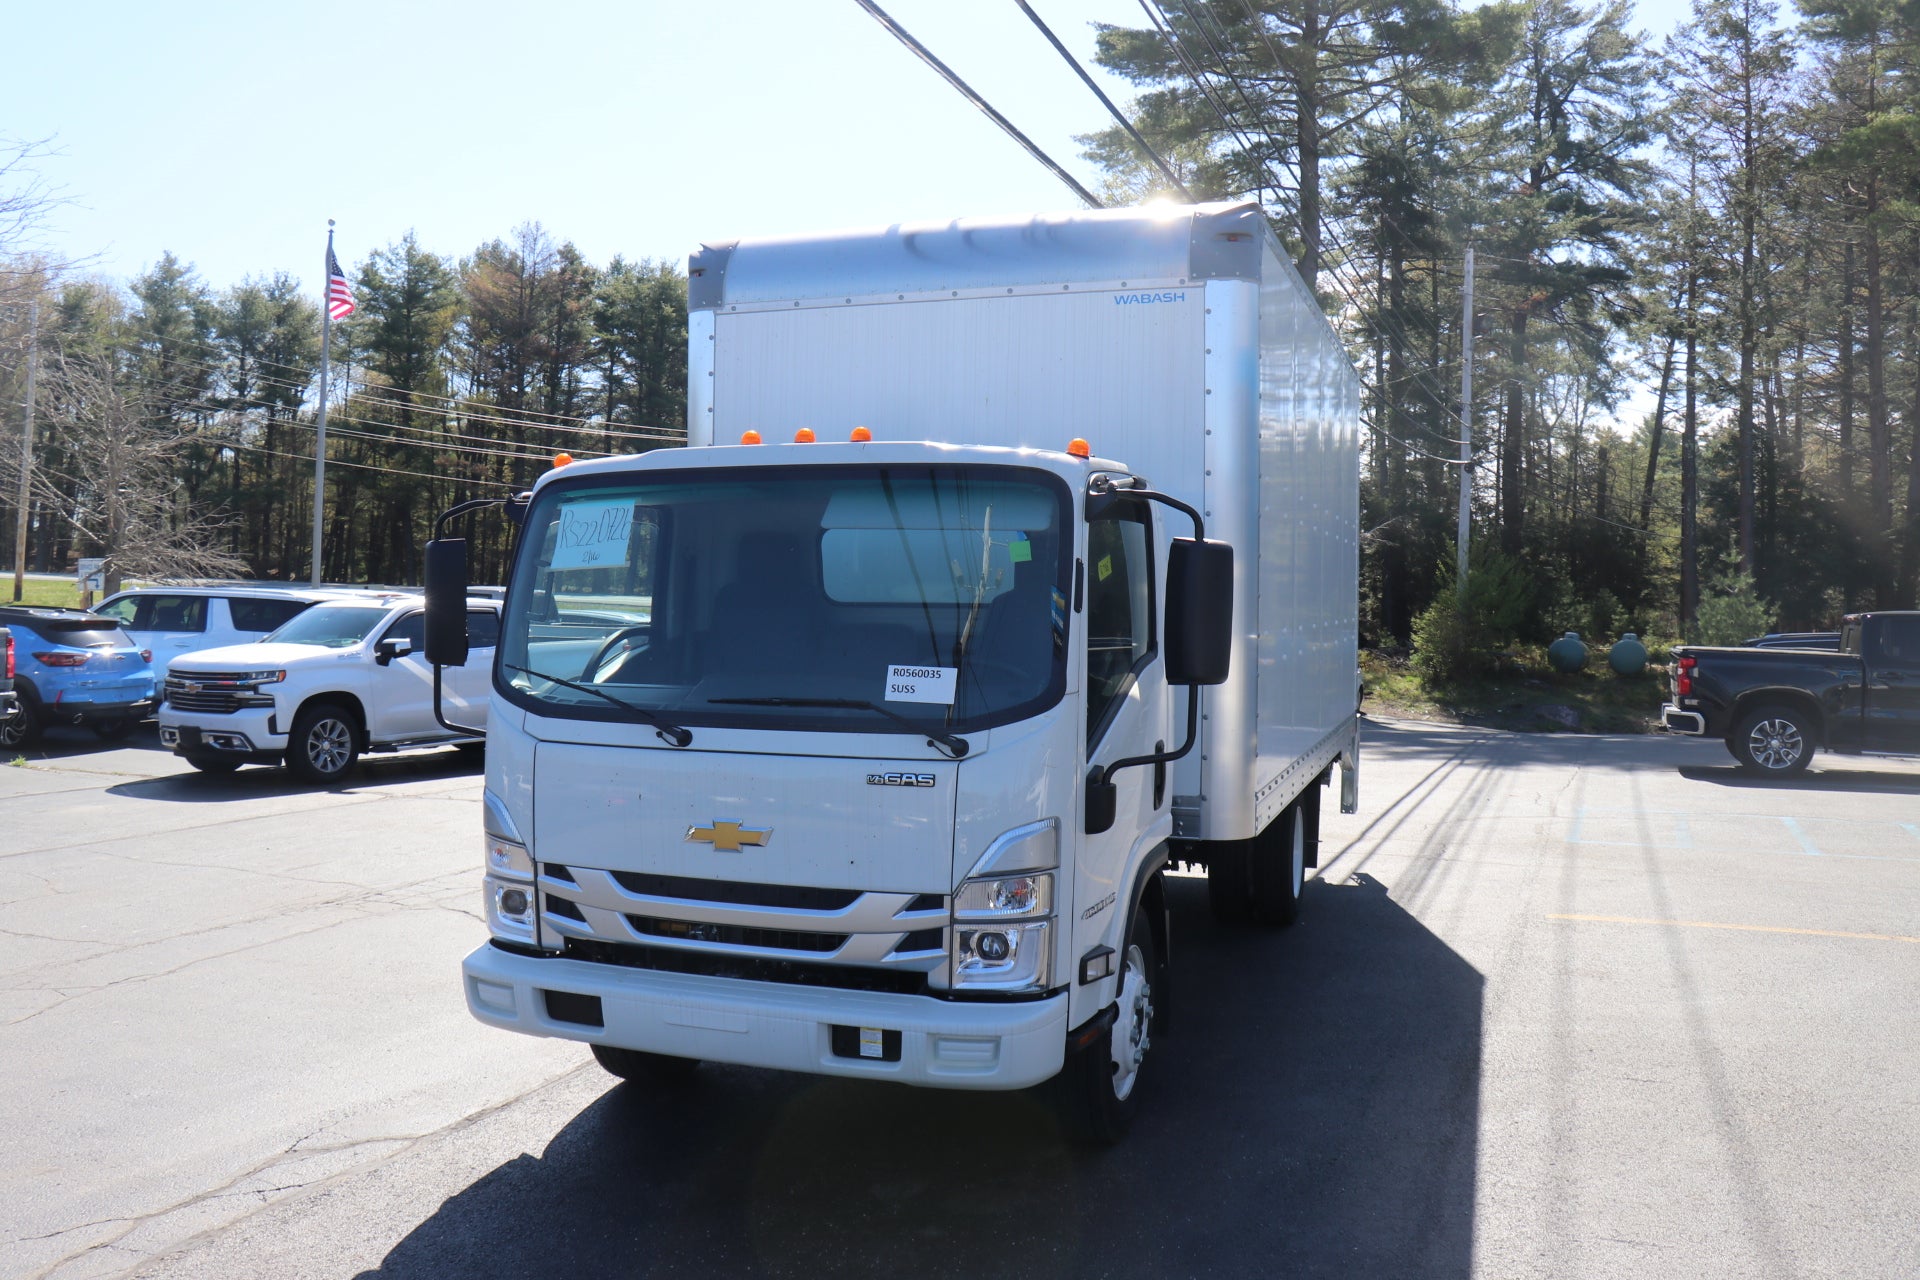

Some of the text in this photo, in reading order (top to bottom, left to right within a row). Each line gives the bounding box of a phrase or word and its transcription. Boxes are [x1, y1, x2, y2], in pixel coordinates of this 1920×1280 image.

[1114, 292, 1185, 305] WABASH
[893, 668, 942, 679] R0560035
[891, 684, 916, 694] SUSS
